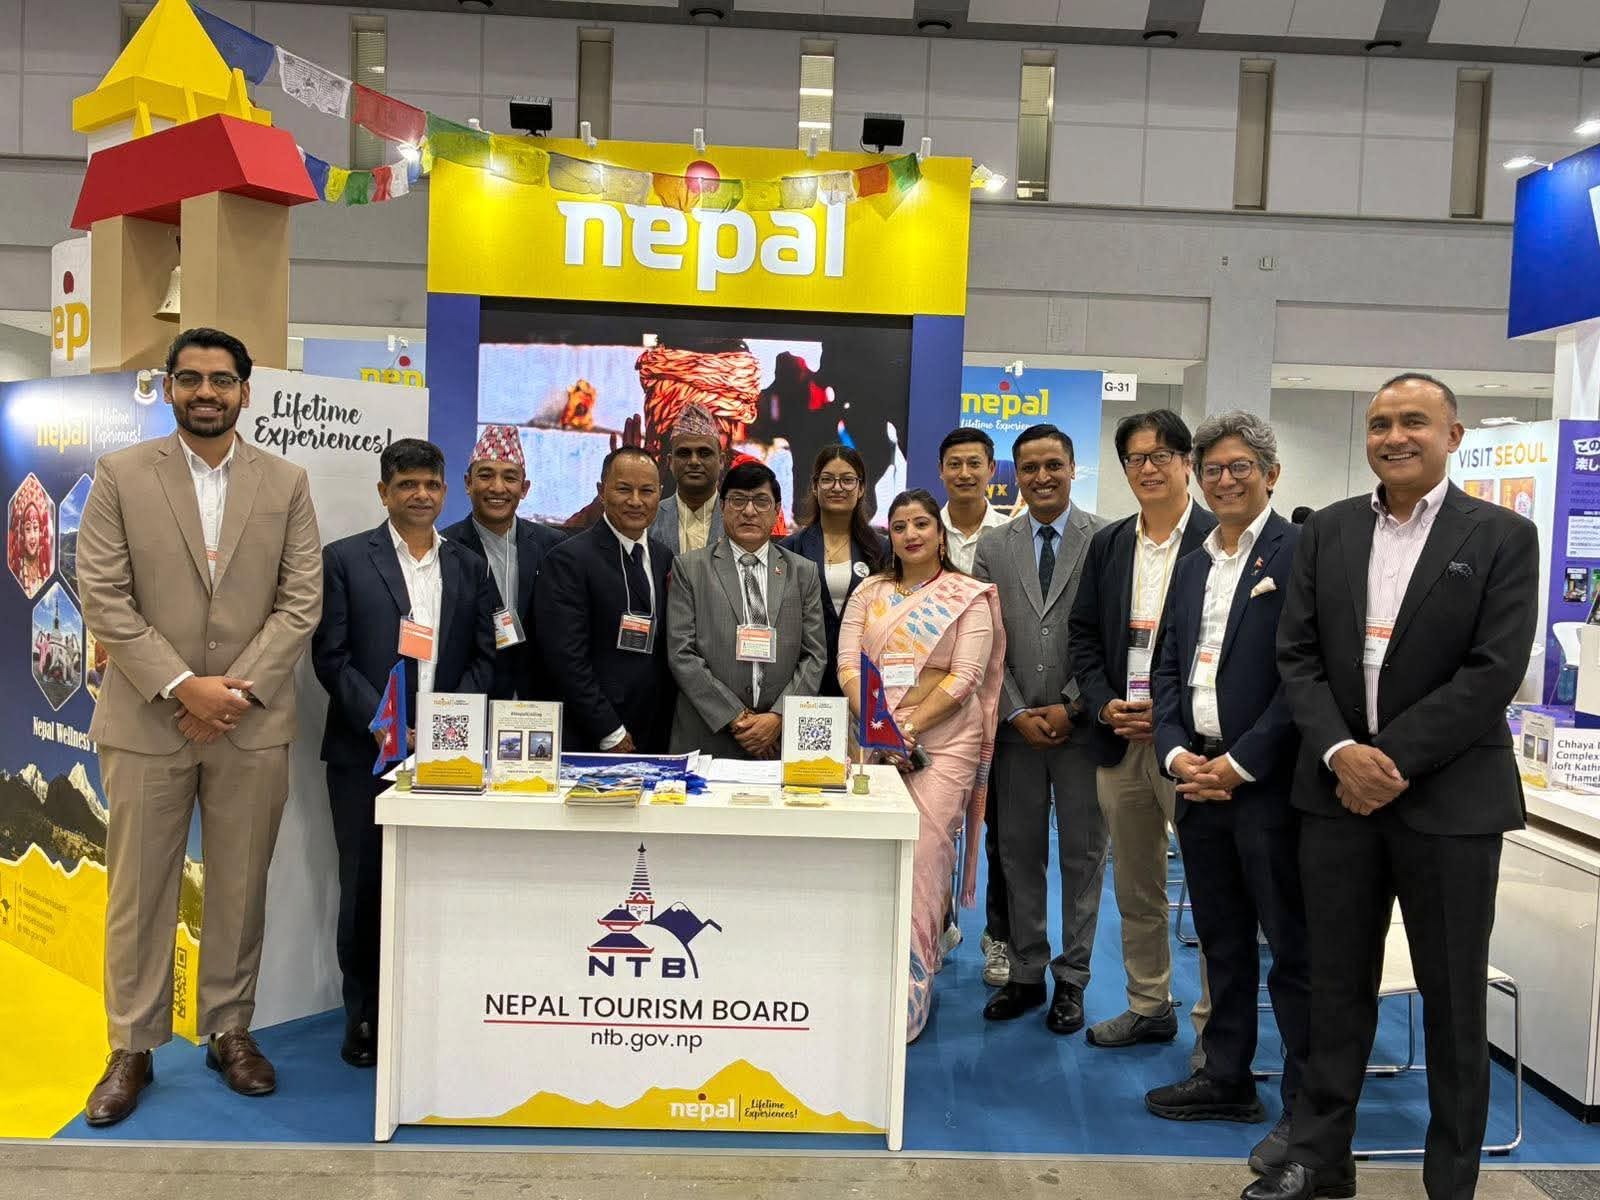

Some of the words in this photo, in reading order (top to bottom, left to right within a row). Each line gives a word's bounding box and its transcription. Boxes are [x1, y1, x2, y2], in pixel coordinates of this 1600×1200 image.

[557, 191, 846, 291] nepal
[52, 302, 90, 361] ep
[1104, 382, 1131, 393] G-31
[272, 391, 362, 430] Lifetime
[961, 389, 1049, 420] nepal
[36, 414, 89, 455] nepal
[254, 416, 393, 455] Experiences!
[1459, 447, 1493, 469] VISIT
[1495, 441, 1548, 467] SEOUL
[33, 716, 55, 741] Nepal
[56, 722, 91, 752] Wellness
[1558, 740, 1594, 751] Chhaya
[1552, 762, 1572, 771] loft
[1556, 751, 1599, 761] Complex
[588, 956, 687, 979] NTB
[485, 994, 570, 1017] NEPAL
[579, 996, 703, 1020] TOURISM
[712, 1000, 810, 1023] BOARD
[591, 1028, 703, 1053] ntb.gov.np
[670, 1098, 736, 1122] nepal
[744, 1107, 798, 1120] Experiences!
[751, 1099, 785, 1112] Lifetime
